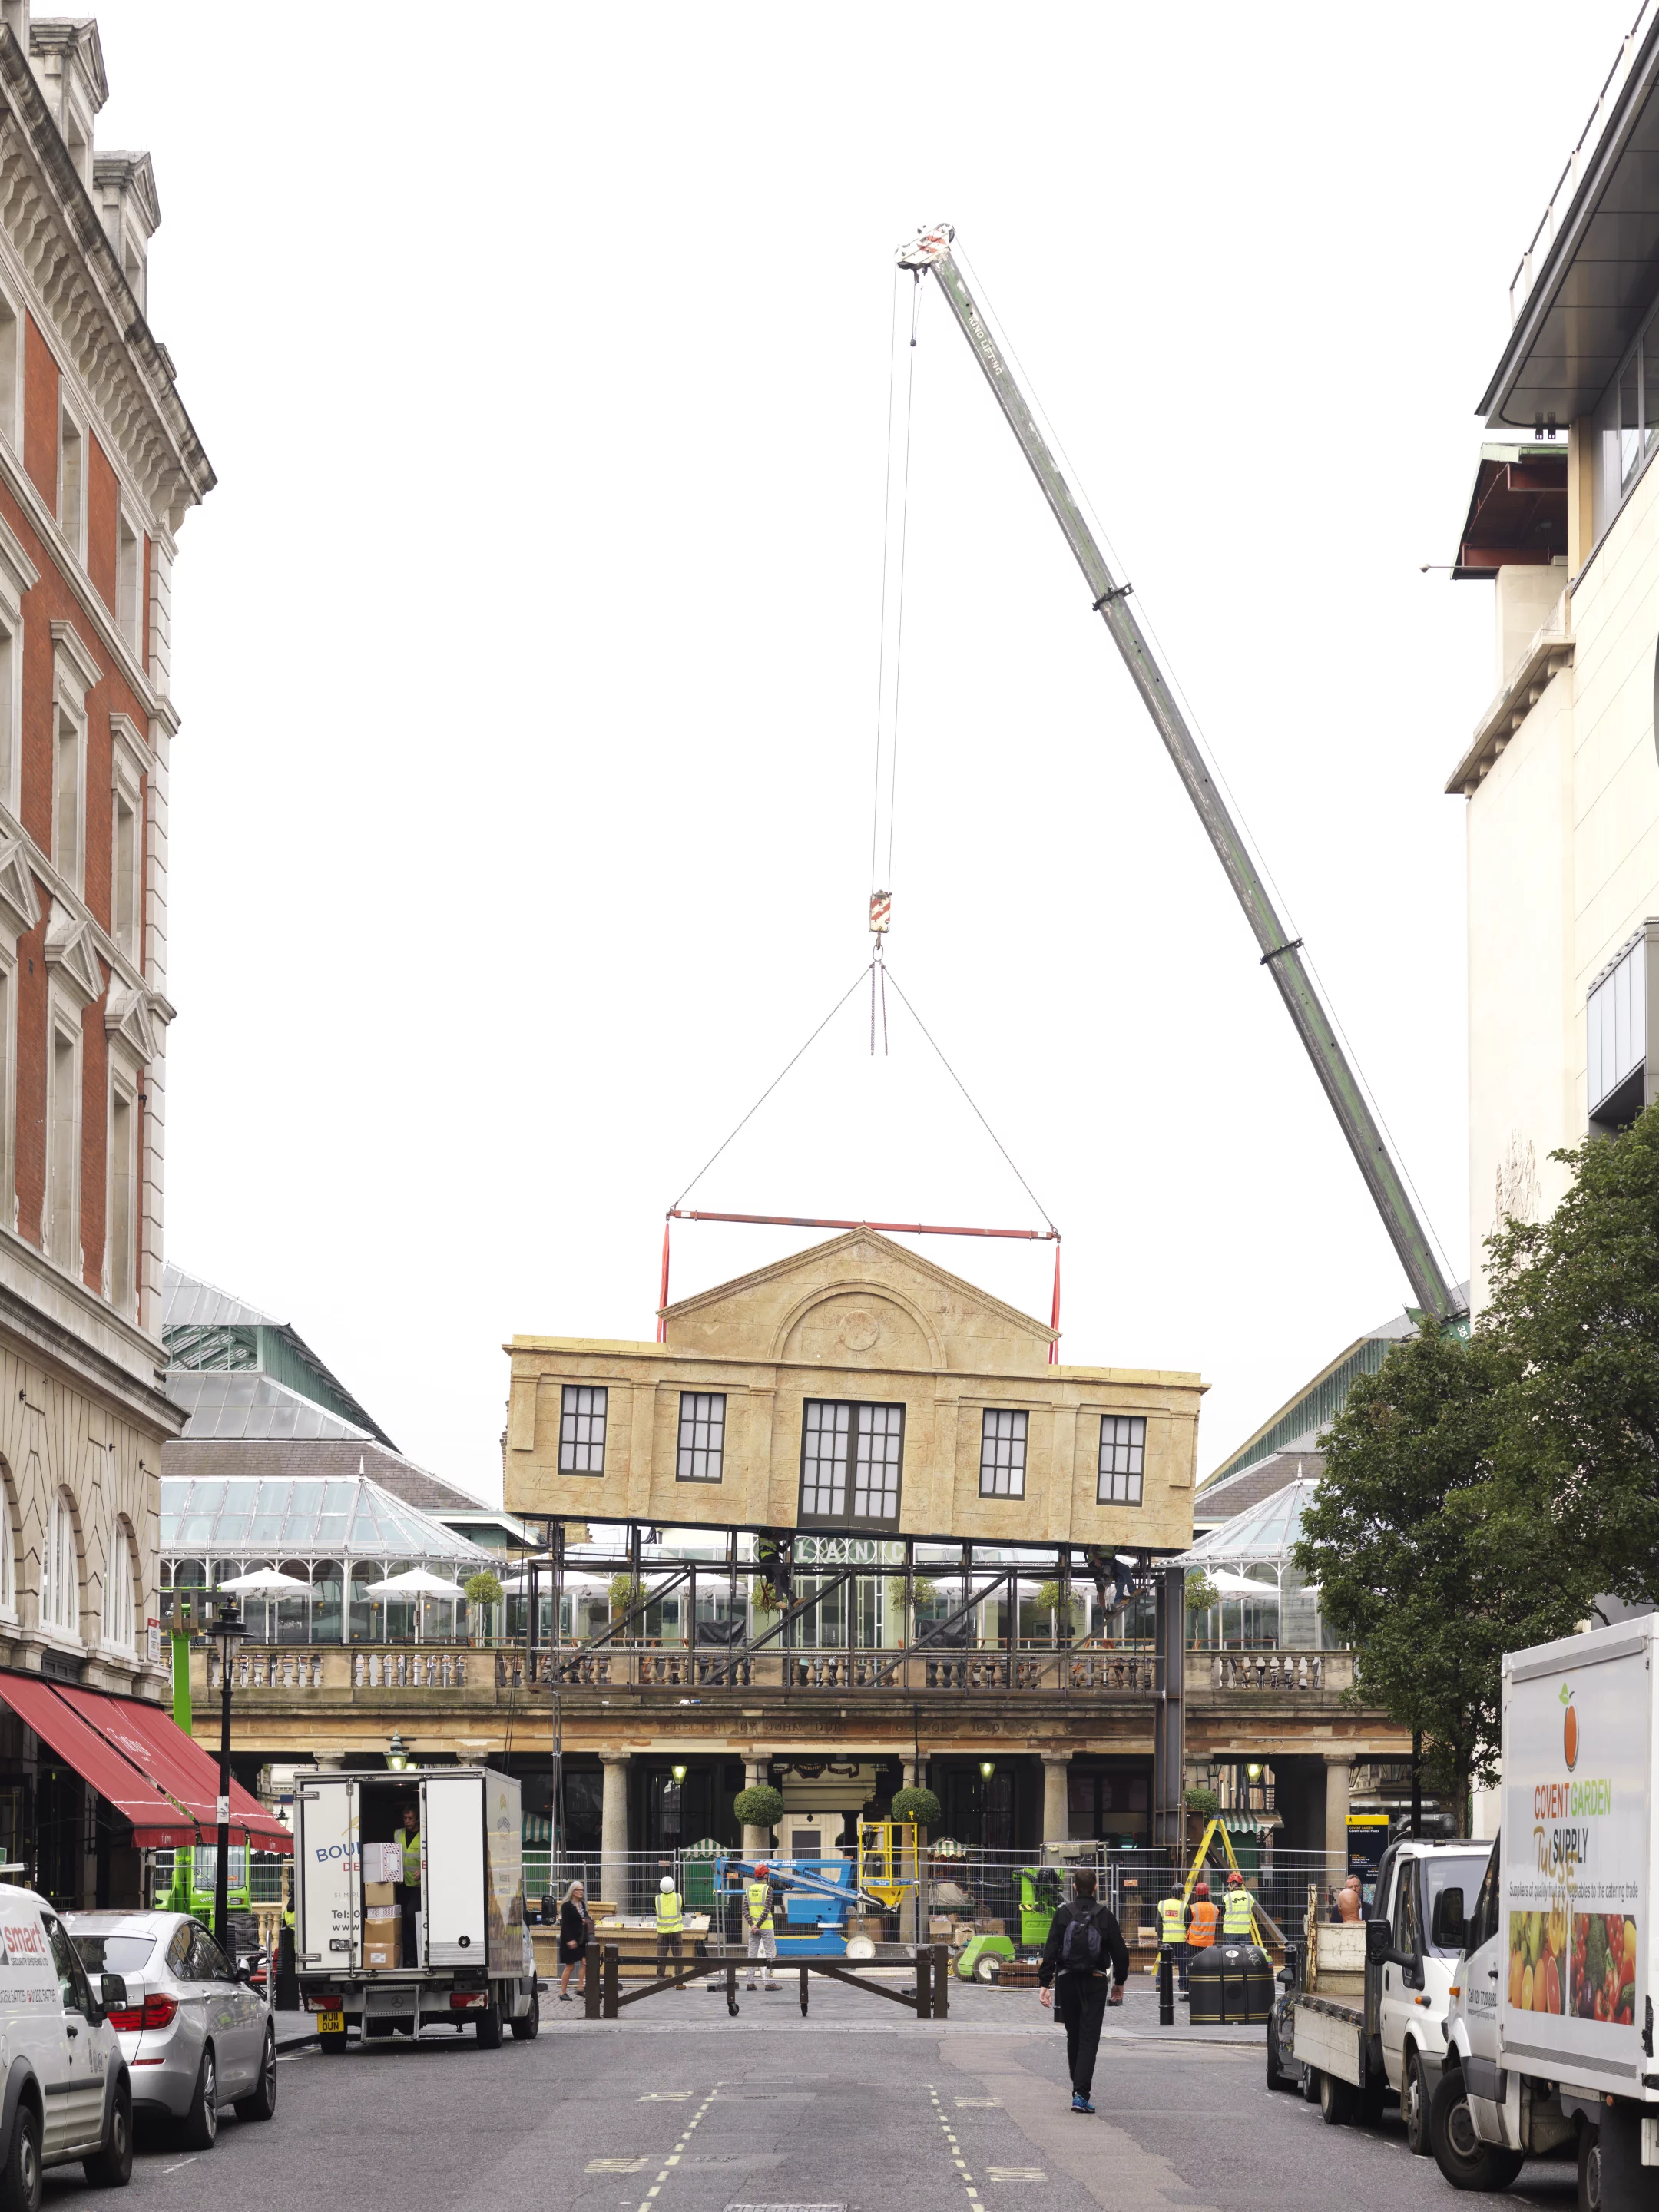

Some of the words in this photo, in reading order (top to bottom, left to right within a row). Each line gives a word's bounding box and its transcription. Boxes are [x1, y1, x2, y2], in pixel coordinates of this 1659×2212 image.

[980, 339, 1002, 376] LIFTING
[797, 1538, 904, 1561] LANC
[663, 1722, 727, 1732] ERECTED
[740, 1722, 757, 1732] BY
[766, 1722, 802, 1732] JOHN
[895, 1723, 959, 1733] BEDFORD
[1535, 1782, 1570, 1820] COVENT
[1571, 1778, 1611, 1818] GARDEN
[1553, 1827, 1589, 1864] SUPPLY
[1591, 1883, 1597, 1899] to
[1605, 1880, 1624, 1903] catering
[1625, 1880, 1639, 1899] trade
[331, 1909, 350, 1919] Tel:
[4, 1921, 45, 1952] smart
[10, 1957, 28, 1966] SECURITY
[27, 1957, 42, 1966] SYSTEMS
[322, 2022, 339, 2031] OUN
